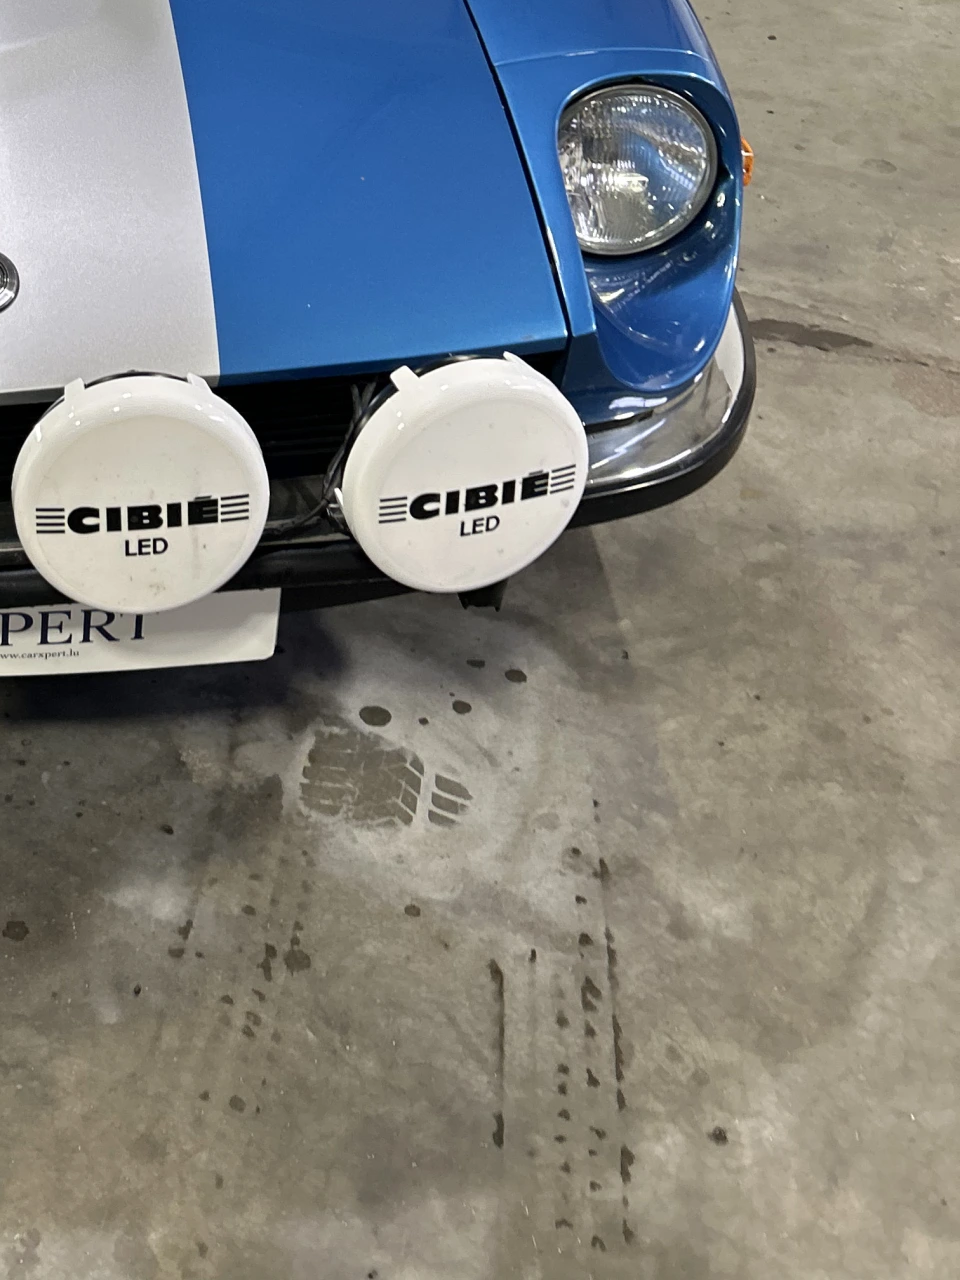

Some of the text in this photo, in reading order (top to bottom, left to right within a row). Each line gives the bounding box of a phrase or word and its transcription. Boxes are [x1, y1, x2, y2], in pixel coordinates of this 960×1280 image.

[409, 469, 549, 520] CIBIÉ
[67, 495, 218, 534] CIBIÉ
[460, 515, 500, 537] LED
[125, 538, 169, 557] LED
